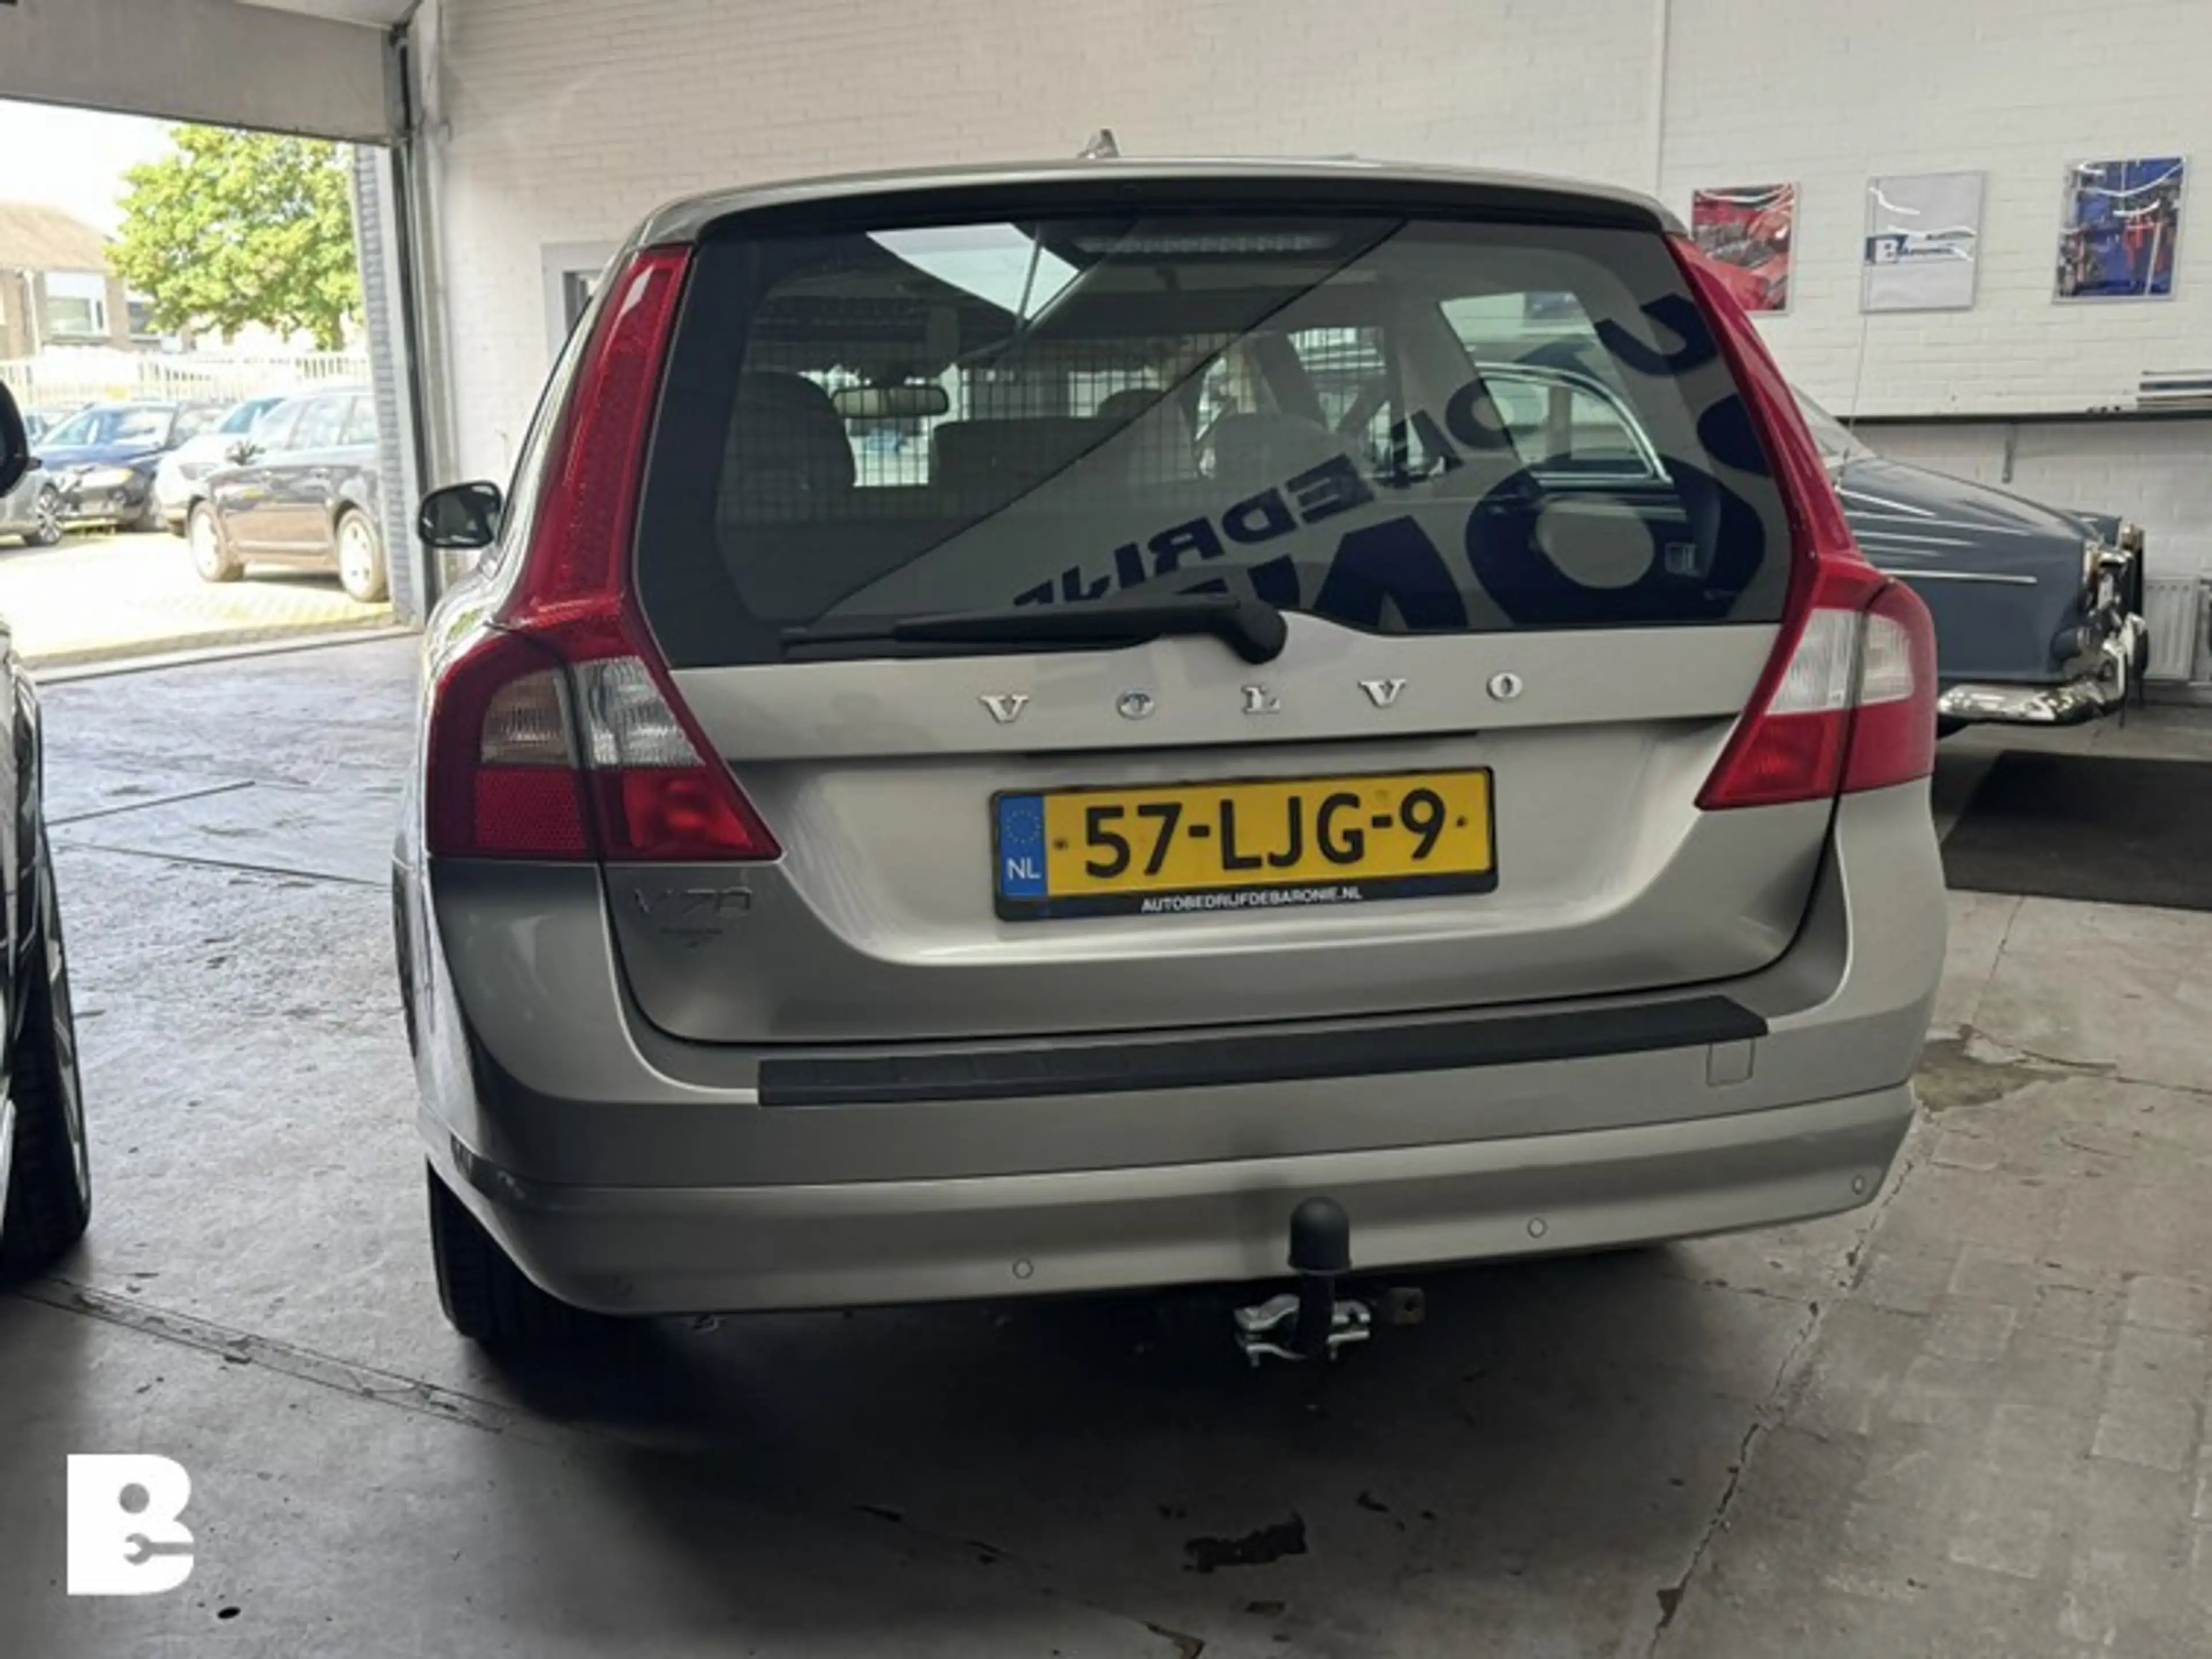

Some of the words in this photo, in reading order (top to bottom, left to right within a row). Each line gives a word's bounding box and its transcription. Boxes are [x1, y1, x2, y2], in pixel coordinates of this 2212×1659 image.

[981, 671, 1524, 724] VOLVO
[1085, 788, 1446, 878] 57-LJG-9
[1006, 858, 1041, 881] NL
[1141, 887, 1363, 914] AUTOBEDRIJFDEBARONIE.NL
